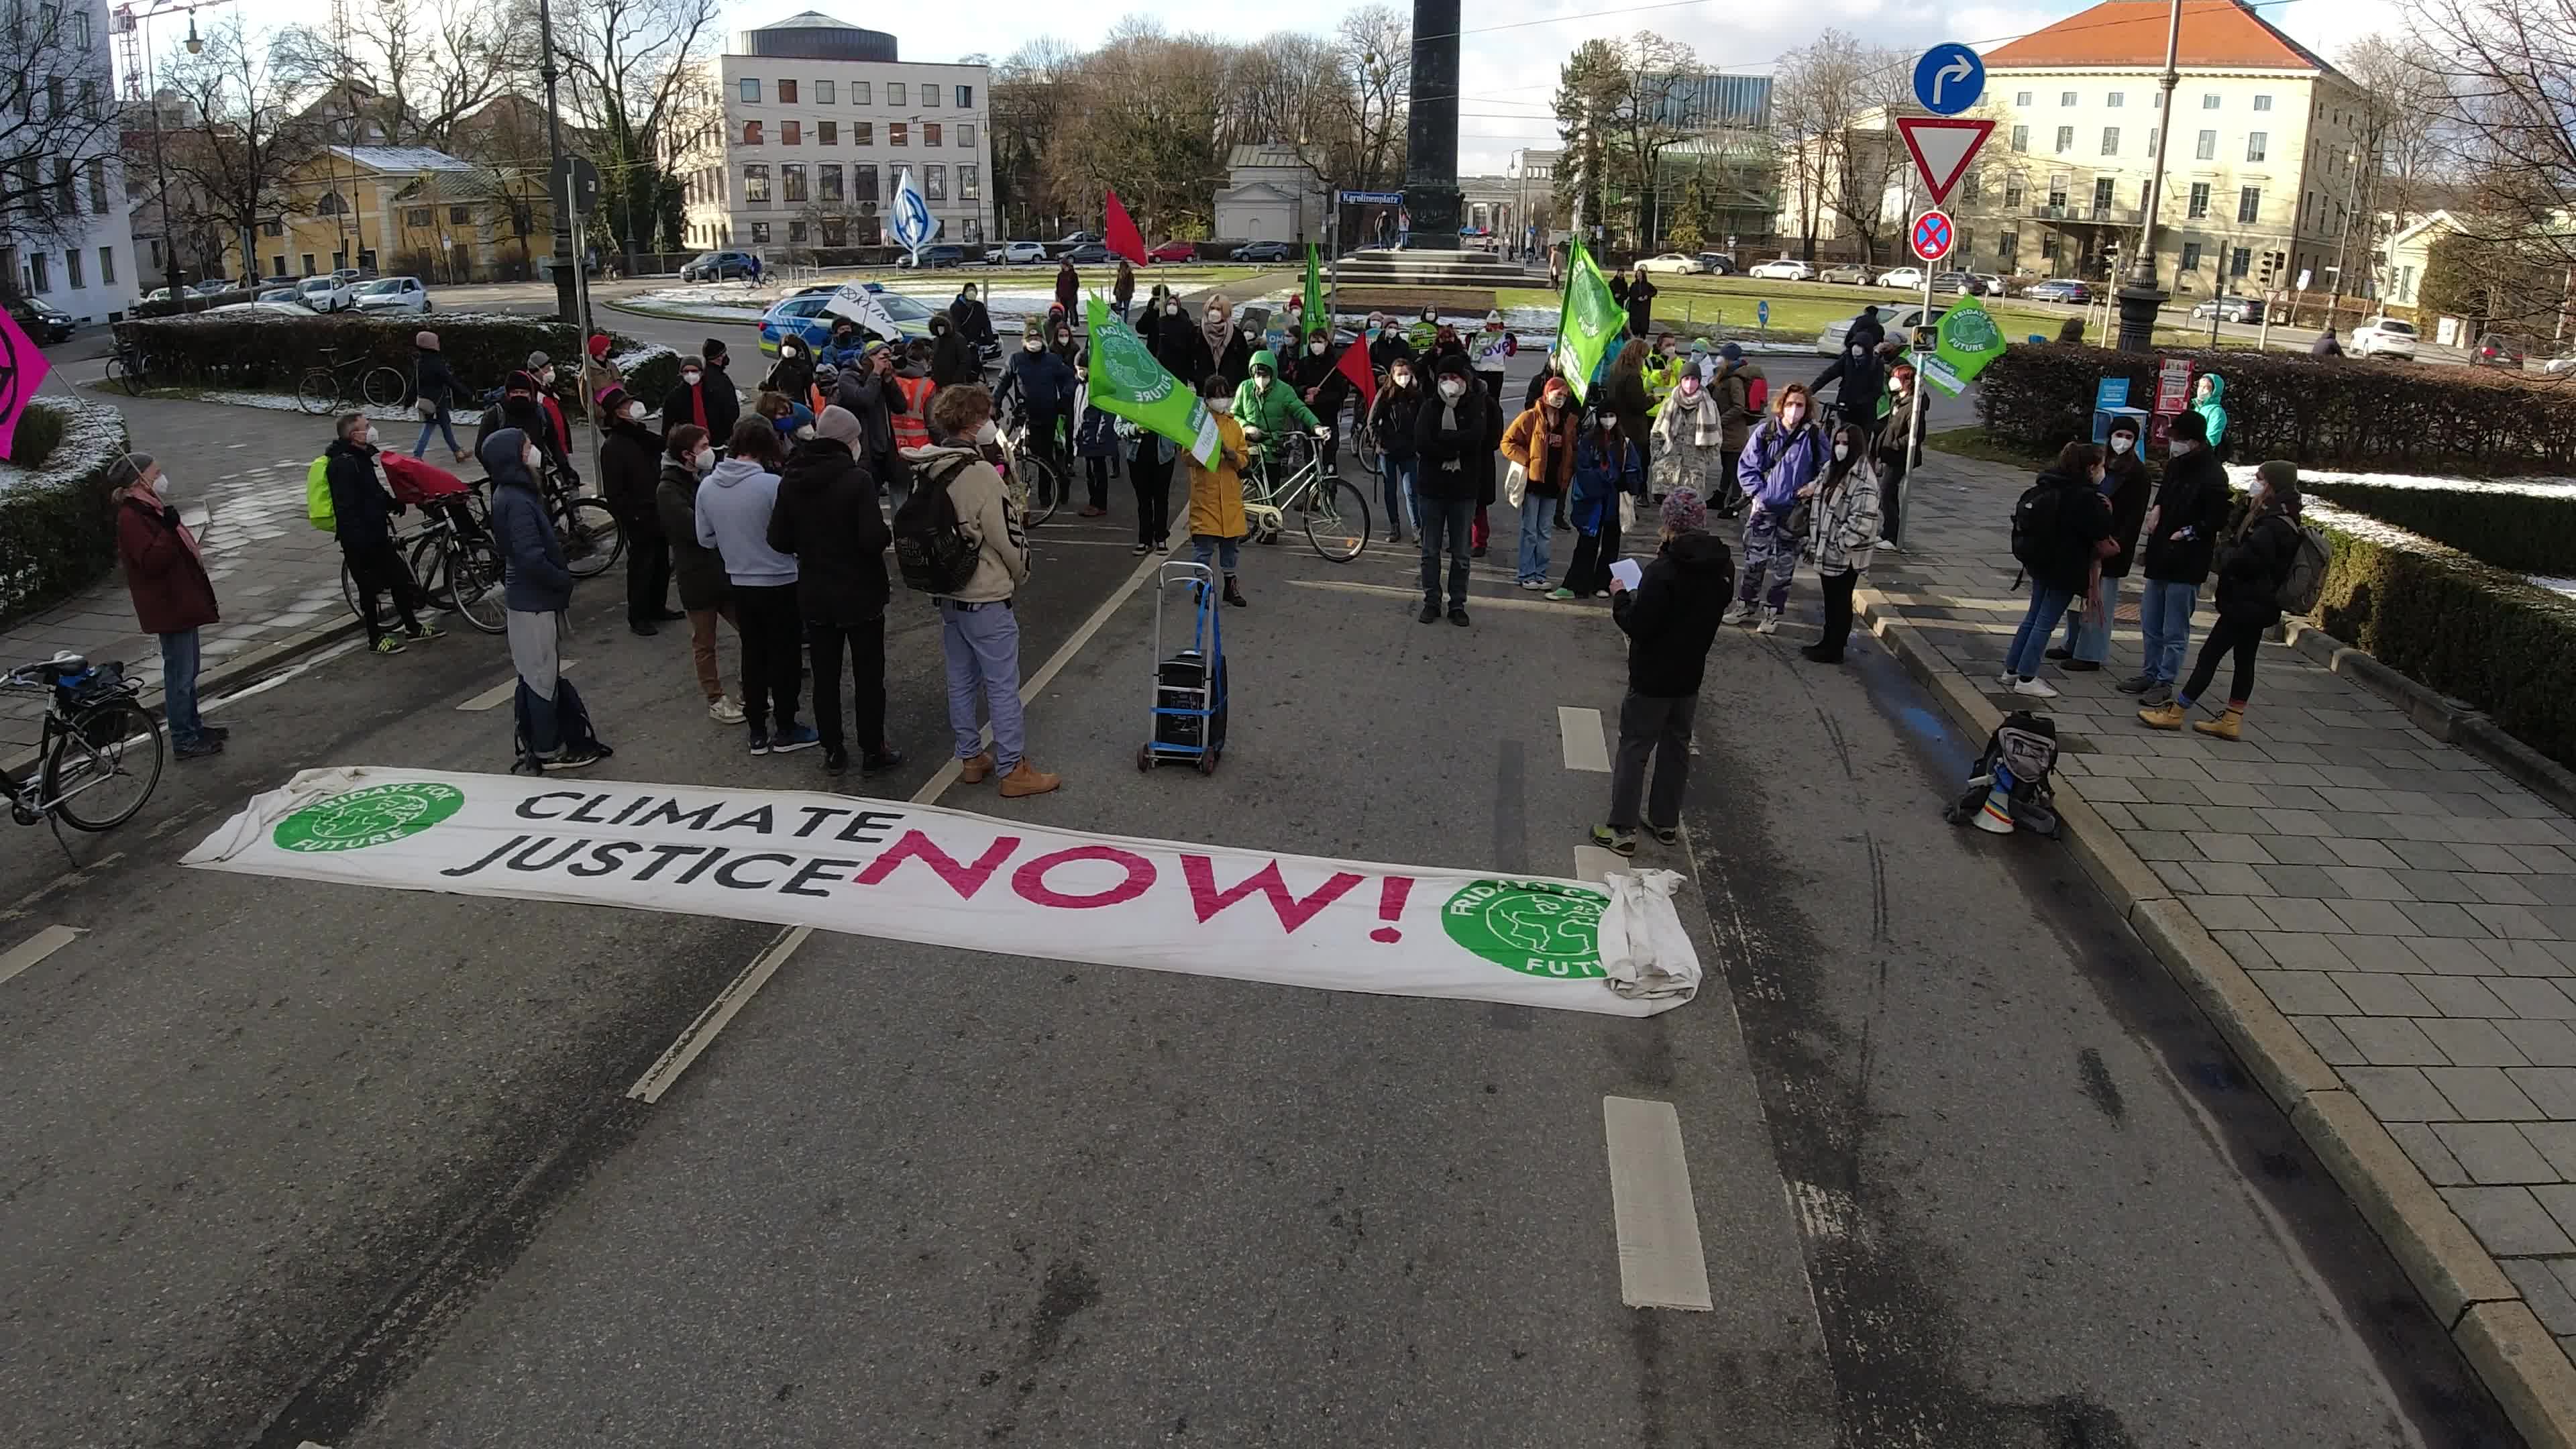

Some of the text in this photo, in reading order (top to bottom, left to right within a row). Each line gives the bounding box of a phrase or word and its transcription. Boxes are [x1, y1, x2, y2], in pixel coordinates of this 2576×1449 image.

[1343, 194, 1398, 205] Karolinenplatz
[1953, 309, 1988, 321] FRIDAYS
[1948, 337, 1985, 352] FUTURE
[420, 785, 456, 801] FOR
[515, 792, 905, 845] CLIMATE
[290, 828, 408, 851] FUTURE
[441, 835, 861, 898] JUSTICE
[853, 828, 1415, 945] NOW!
